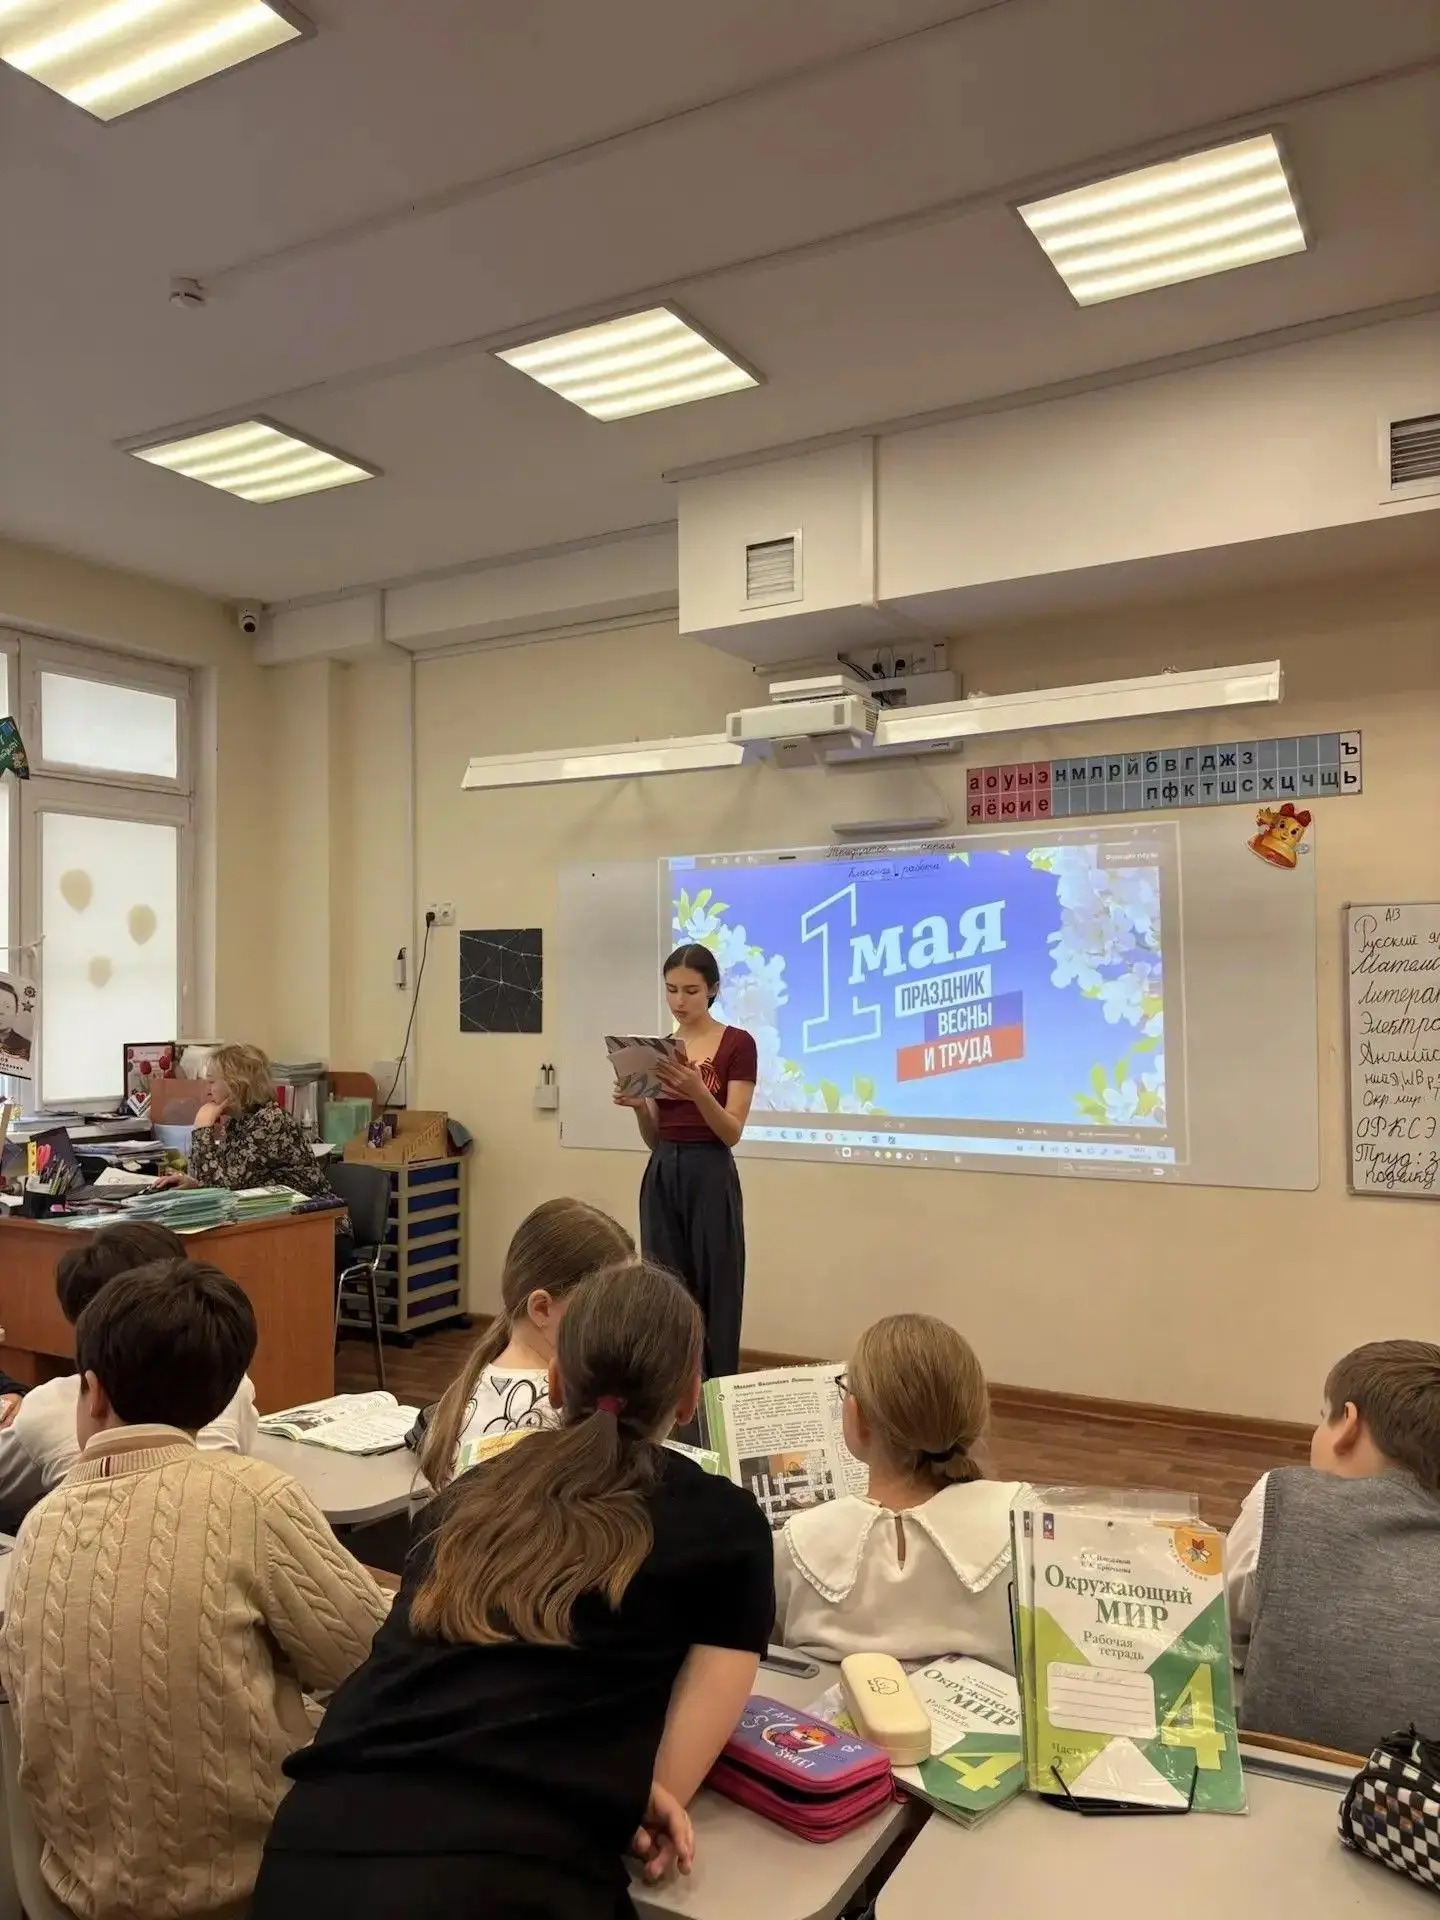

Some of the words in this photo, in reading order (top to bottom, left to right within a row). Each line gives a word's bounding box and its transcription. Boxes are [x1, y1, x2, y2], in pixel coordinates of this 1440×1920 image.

[1354, 914, 1418, 958] Русский
[801, 882, 881, 1055] 1
[848, 899, 1007, 985] мая
[900, 970, 985, 1011] ПРАЗДНИК
[937, 1003, 992, 1037] ВЕСНЫ
[924, 1048, 935, 1072] И
[938, 1035, 993, 1069] ТРУДА
[1045, 1564, 1192, 1605] Окружающий
[1096, 1598, 1169, 1630] МИР
[1083, 1630, 1133, 1648] Рабочая
[1099, 1647, 1144, 1661] тетрадь
[945, 1693, 1016, 1727] МИР
[1161, 1663, 1227, 1770] 4
